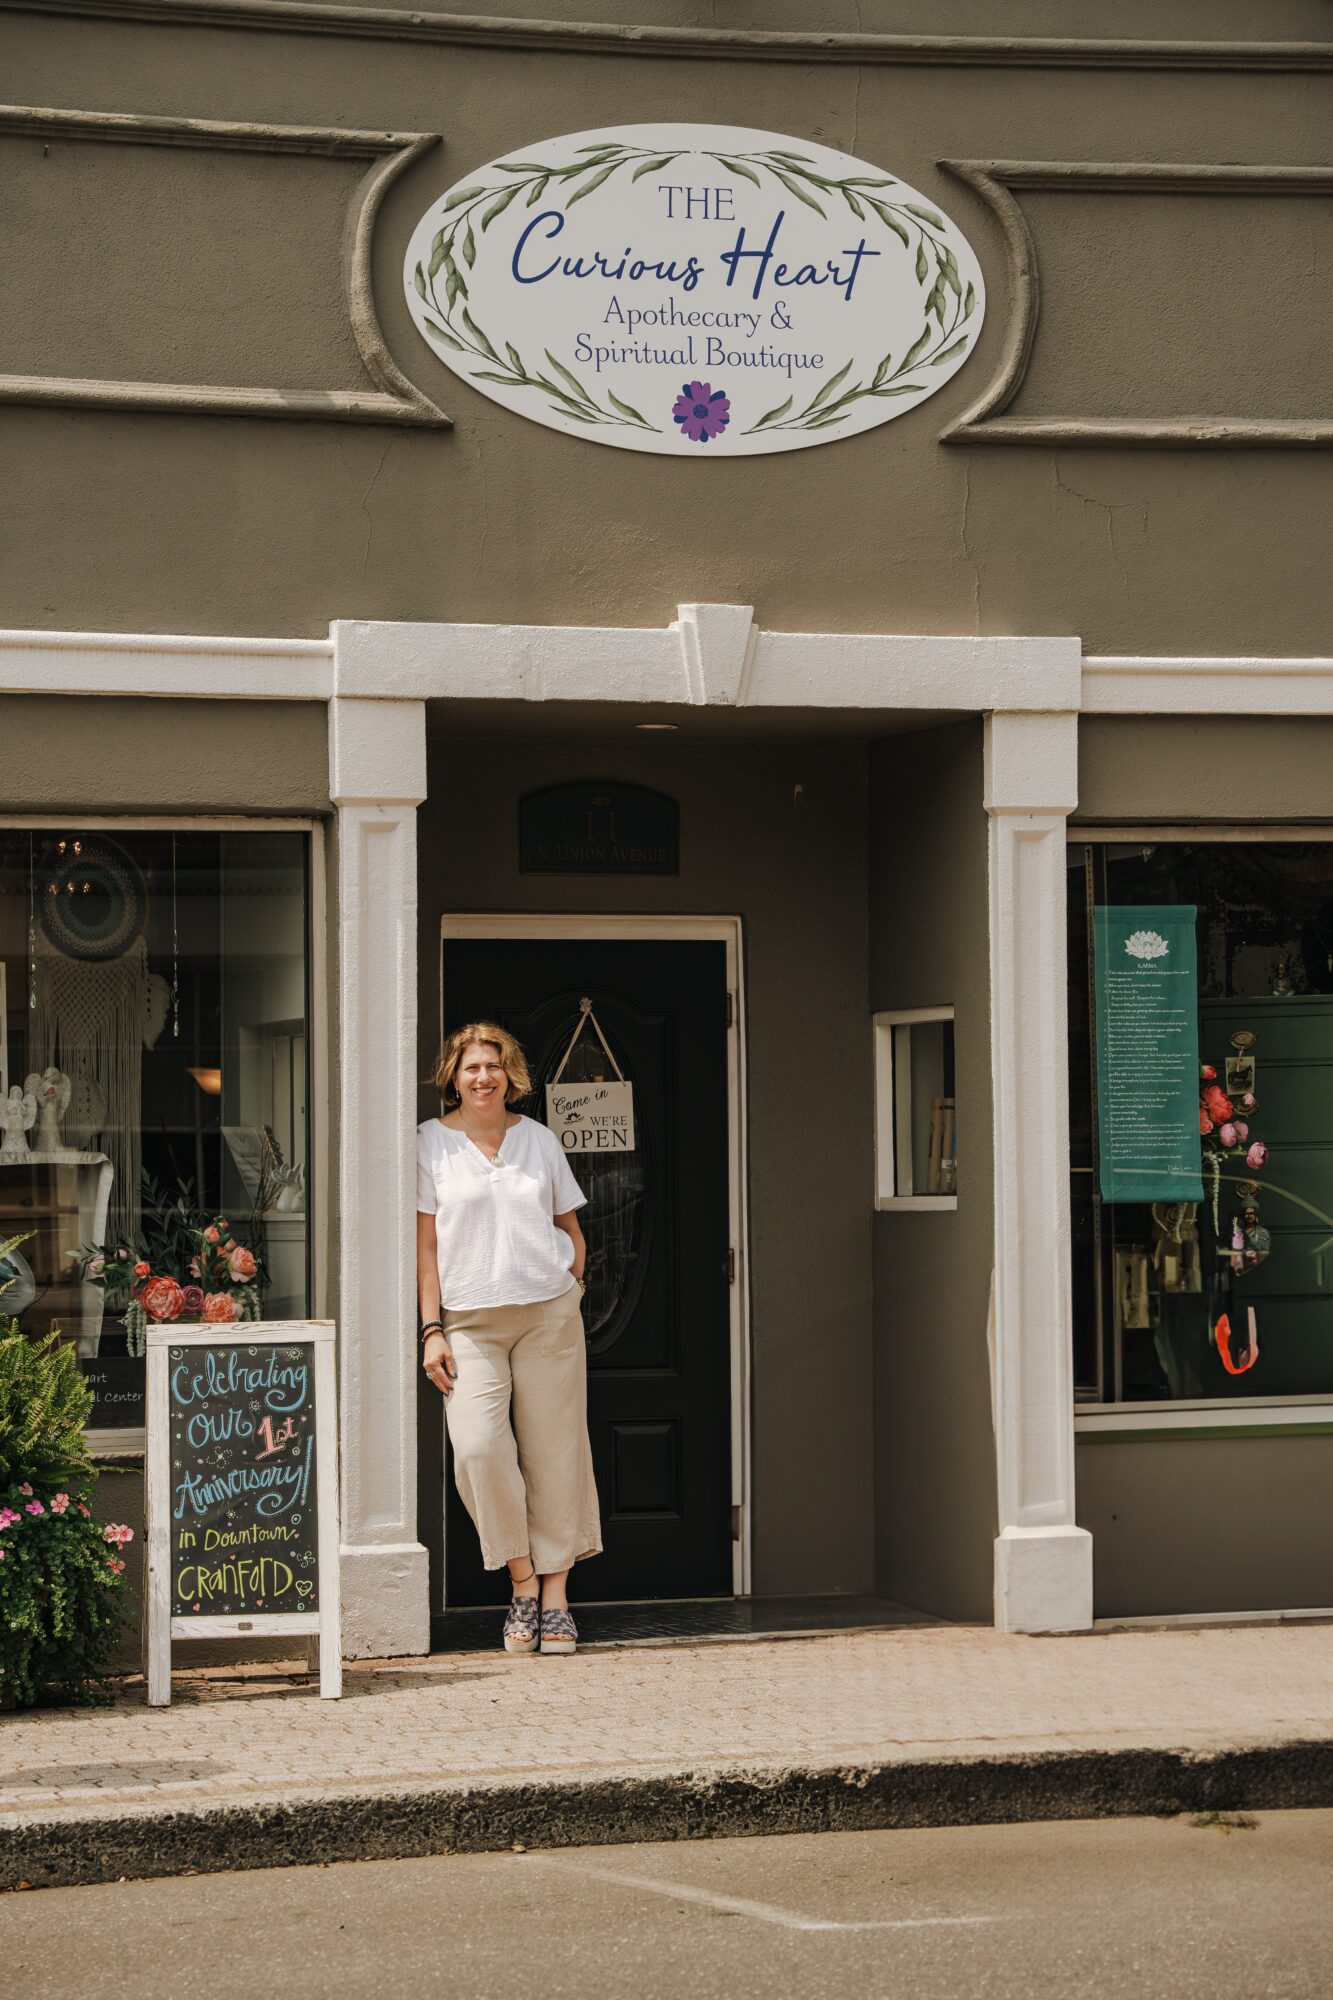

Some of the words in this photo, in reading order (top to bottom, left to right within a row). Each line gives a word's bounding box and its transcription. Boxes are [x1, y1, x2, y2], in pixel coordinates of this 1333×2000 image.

[658, 185, 736, 221] THE
[511, 210, 705, 292] Curious
[720, 210, 881, 301] Heart
[602, 295, 762, 338] Apothecary
[770, 300, 794, 330] &
[574, 333, 697, 373] Spiritual
[705, 336, 824, 378] Boutique
[552, 1097, 590, 1115] Come
[595, 1089, 608, 1101] in
[589, 1115, 628, 1126] WE'RE
[561, 1129, 628, 1149] OPEN
[171, 1349, 307, 1412] Celebrating
[179, 1528, 196, 1548] in
[204, 1523, 297, 1551] Downtown
